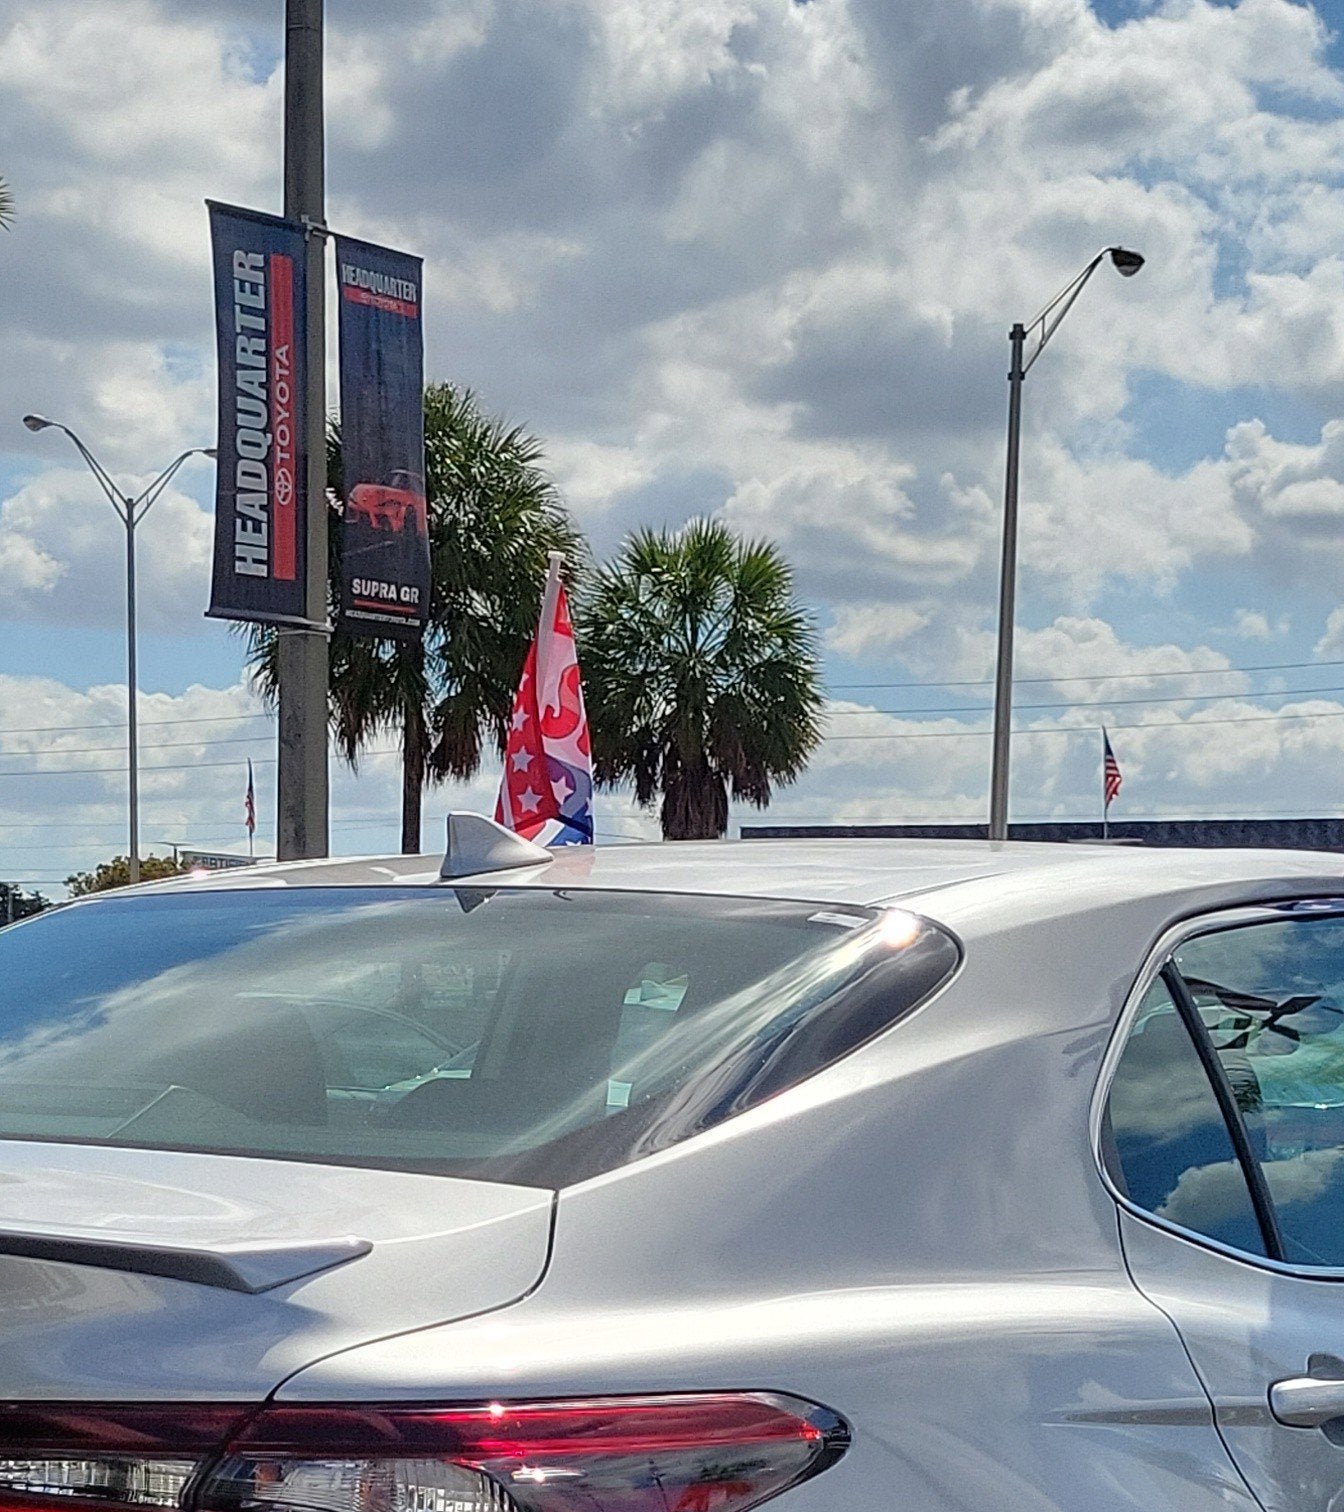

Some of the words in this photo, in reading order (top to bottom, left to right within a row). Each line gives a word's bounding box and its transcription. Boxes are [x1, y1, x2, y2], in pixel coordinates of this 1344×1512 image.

[342, 263, 416, 302] HEADQUARTER
[233, 250, 273, 578] HEADQUARTER
[275, 344, 291, 465] TOYOTA
[352, 578, 397, 601] SUPRA
[400, 586, 419, 603] GR
